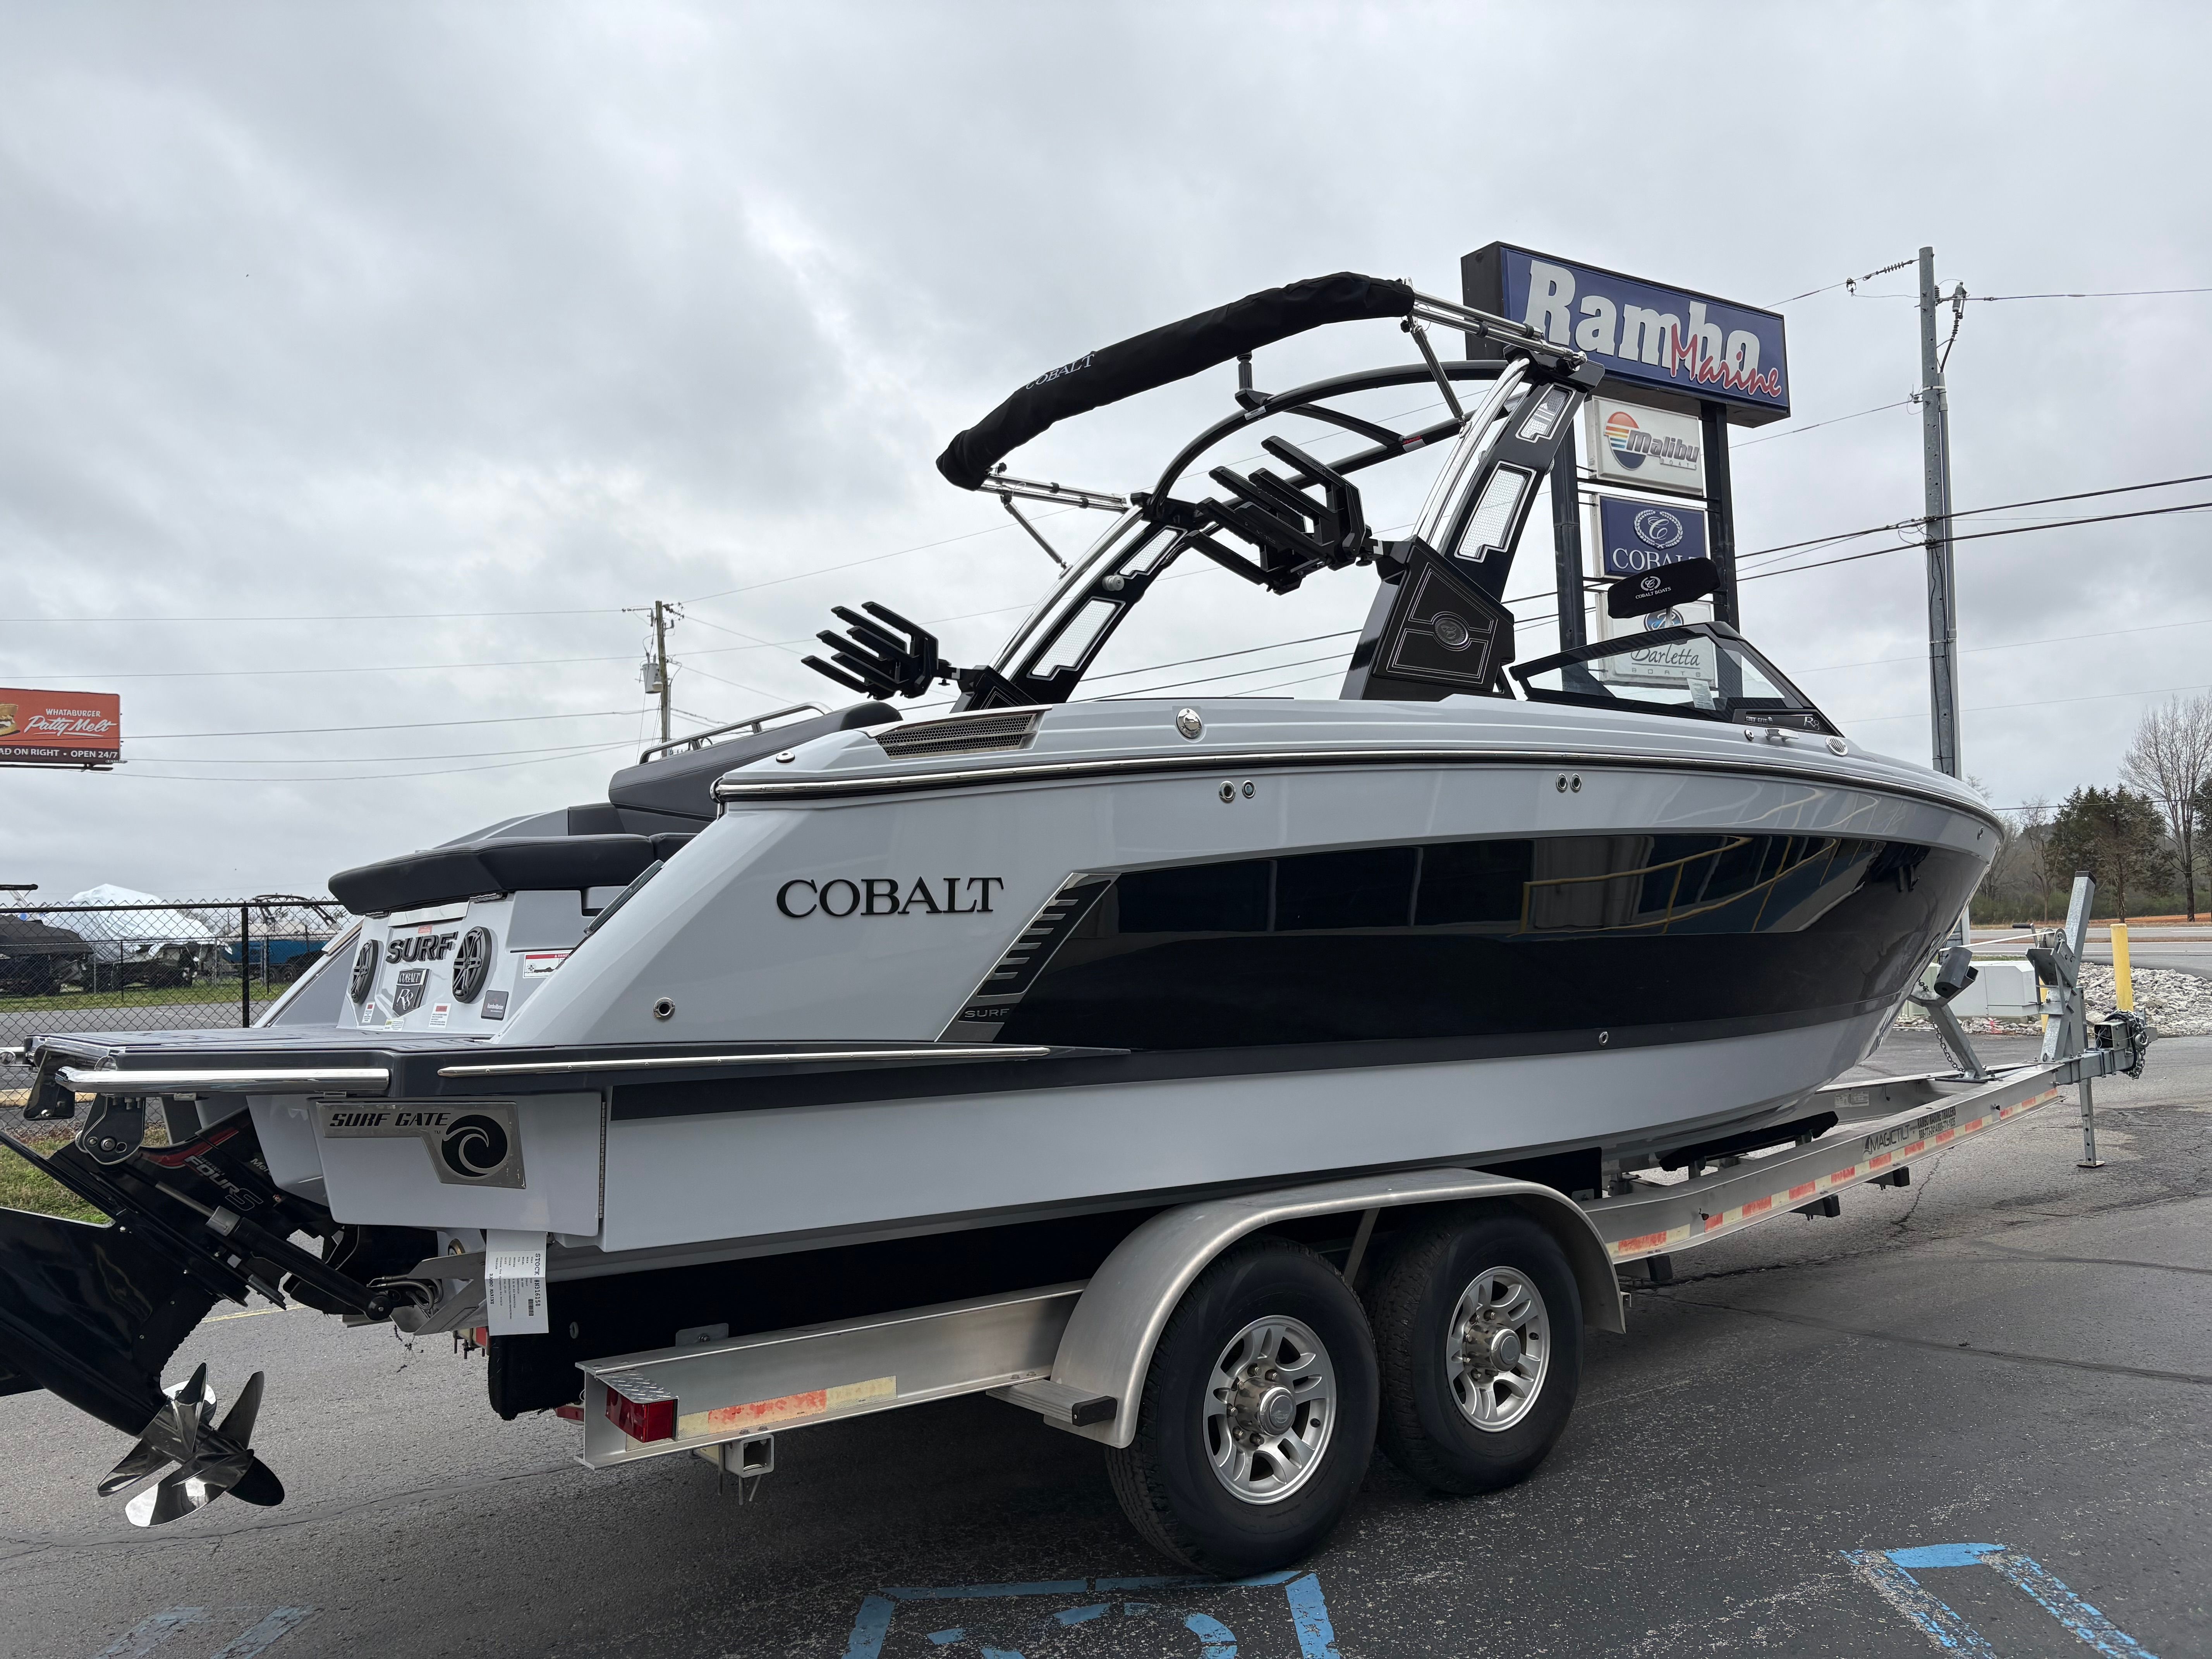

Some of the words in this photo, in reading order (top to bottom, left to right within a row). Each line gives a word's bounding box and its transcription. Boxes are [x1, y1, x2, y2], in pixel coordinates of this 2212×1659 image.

[1525, 260, 1760, 378] Rambo
[1670, 323, 1781, 397] Marine
[1626, 430, 1699, 463] Malibu
[1661, 459, 1697, 471] BOATS
[1613, 548, 1698, 571] COBA
[1632, 668, 1701, 677] BOATS
[46, 708, 101, 717] WHATABURGER
[24, 715, 74, 737] Patty
[68, 718, 118, 732] Melt
[776, 876, 1004, 918] COBALT
[386, 931, 459, 964] SURF
[399, 972, 421, 983] COBALT
[965, 1008, 1010, 1017] SURF
[330, 1113, 390, 1127] SURF
[395, 1112, 451, 1126] GATE
[184, 1155, 240, 1195] FOUR
